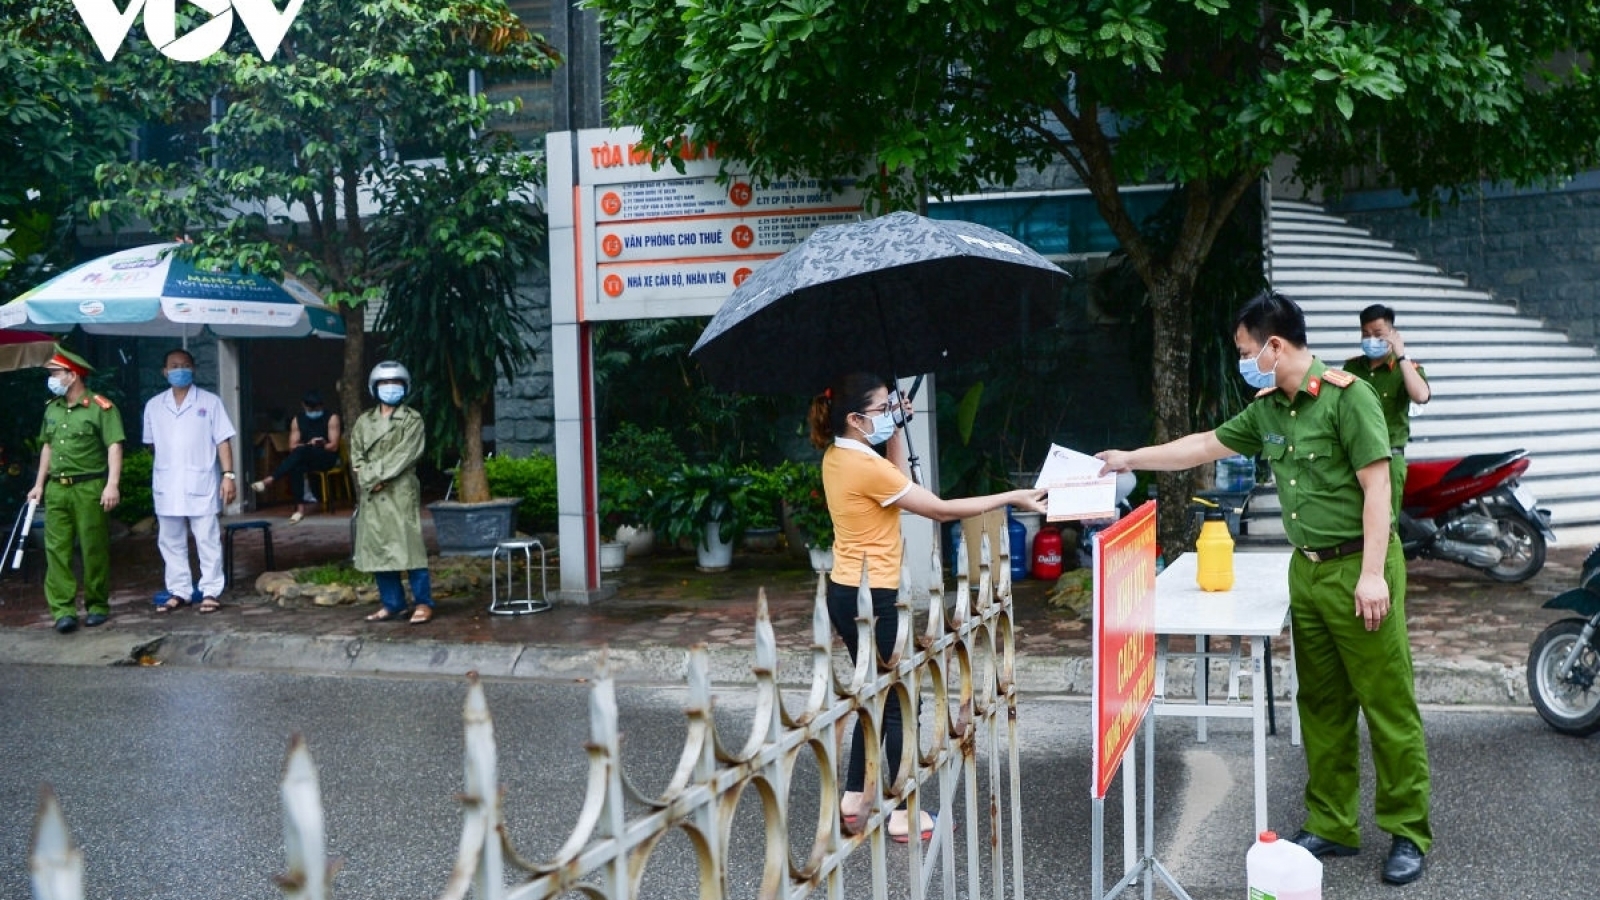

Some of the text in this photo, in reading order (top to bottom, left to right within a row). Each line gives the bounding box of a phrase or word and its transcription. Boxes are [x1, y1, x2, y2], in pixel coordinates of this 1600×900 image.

[591, 141, 623, 169] TÒA
[624, 229, 723, 249] VĂN PHÒNG CHO THUÊ
[627, 275, 642, 288] NHÀ
[644, 275, 653, 287] XE
[655, 273, 670, 286] CÁN
[709, 270, 726, 284] VIÊN
[1118, 633, 1137, 695] CÁCH
